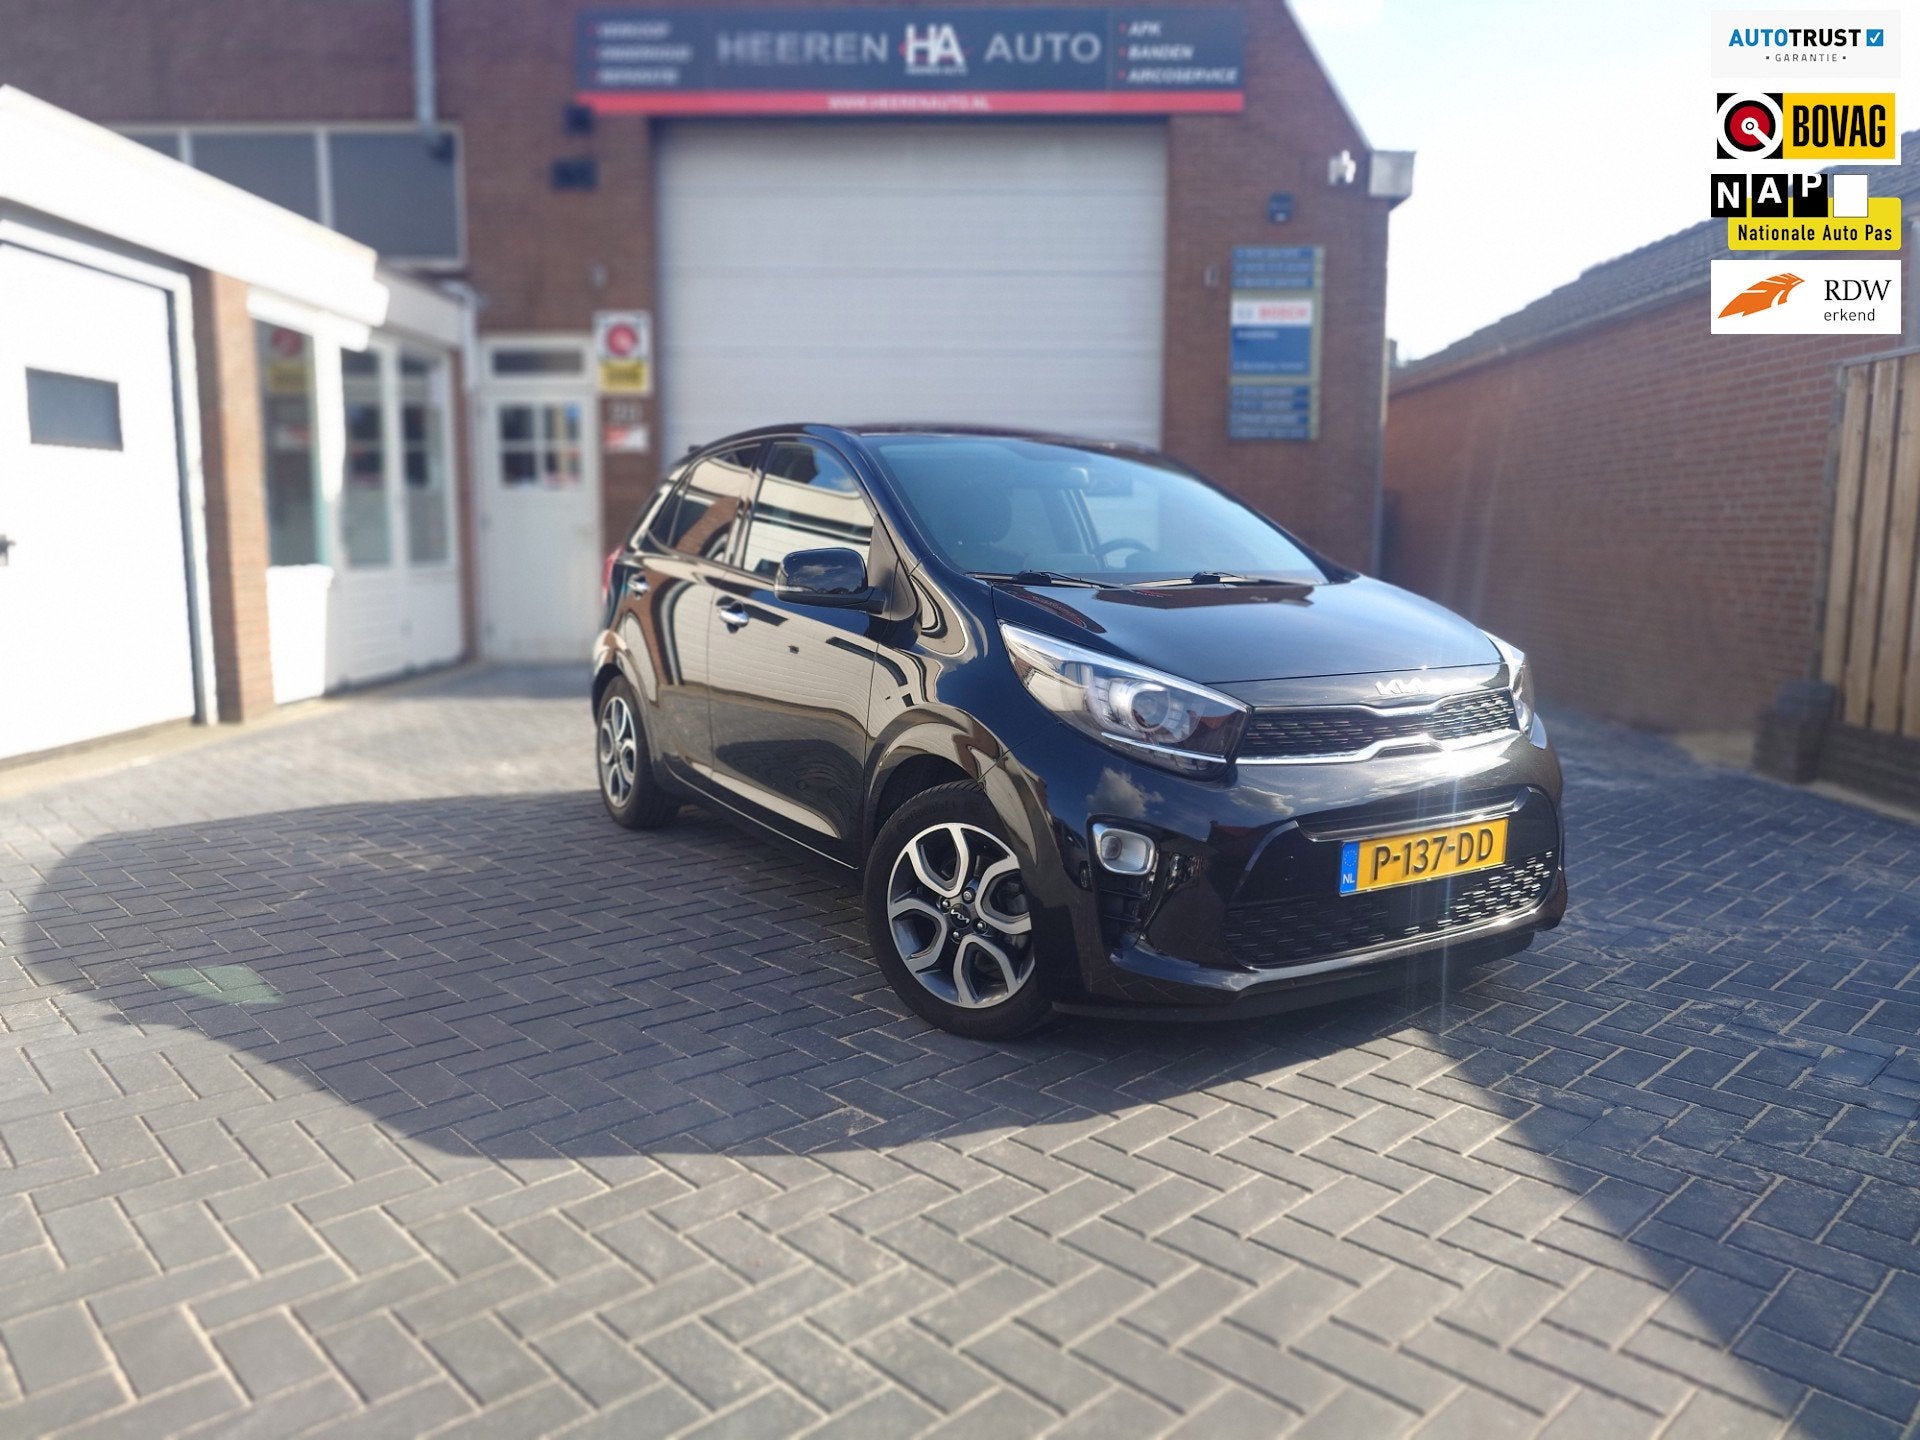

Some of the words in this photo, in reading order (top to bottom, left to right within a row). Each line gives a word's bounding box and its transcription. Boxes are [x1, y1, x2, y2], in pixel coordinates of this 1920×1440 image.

[716, 32, 888, 65] HEEREN
[906, 24, 965, 65] HA
[984, 32, 1101, 63] AUTO
[1127, 44, 1194, 60] BANDEN
[1127, 68, 1237, 84] AIRCOSERVICE
[1342, 873, 1355, 885] NL
[1373, 828, 1494, 881] P-137-DD
